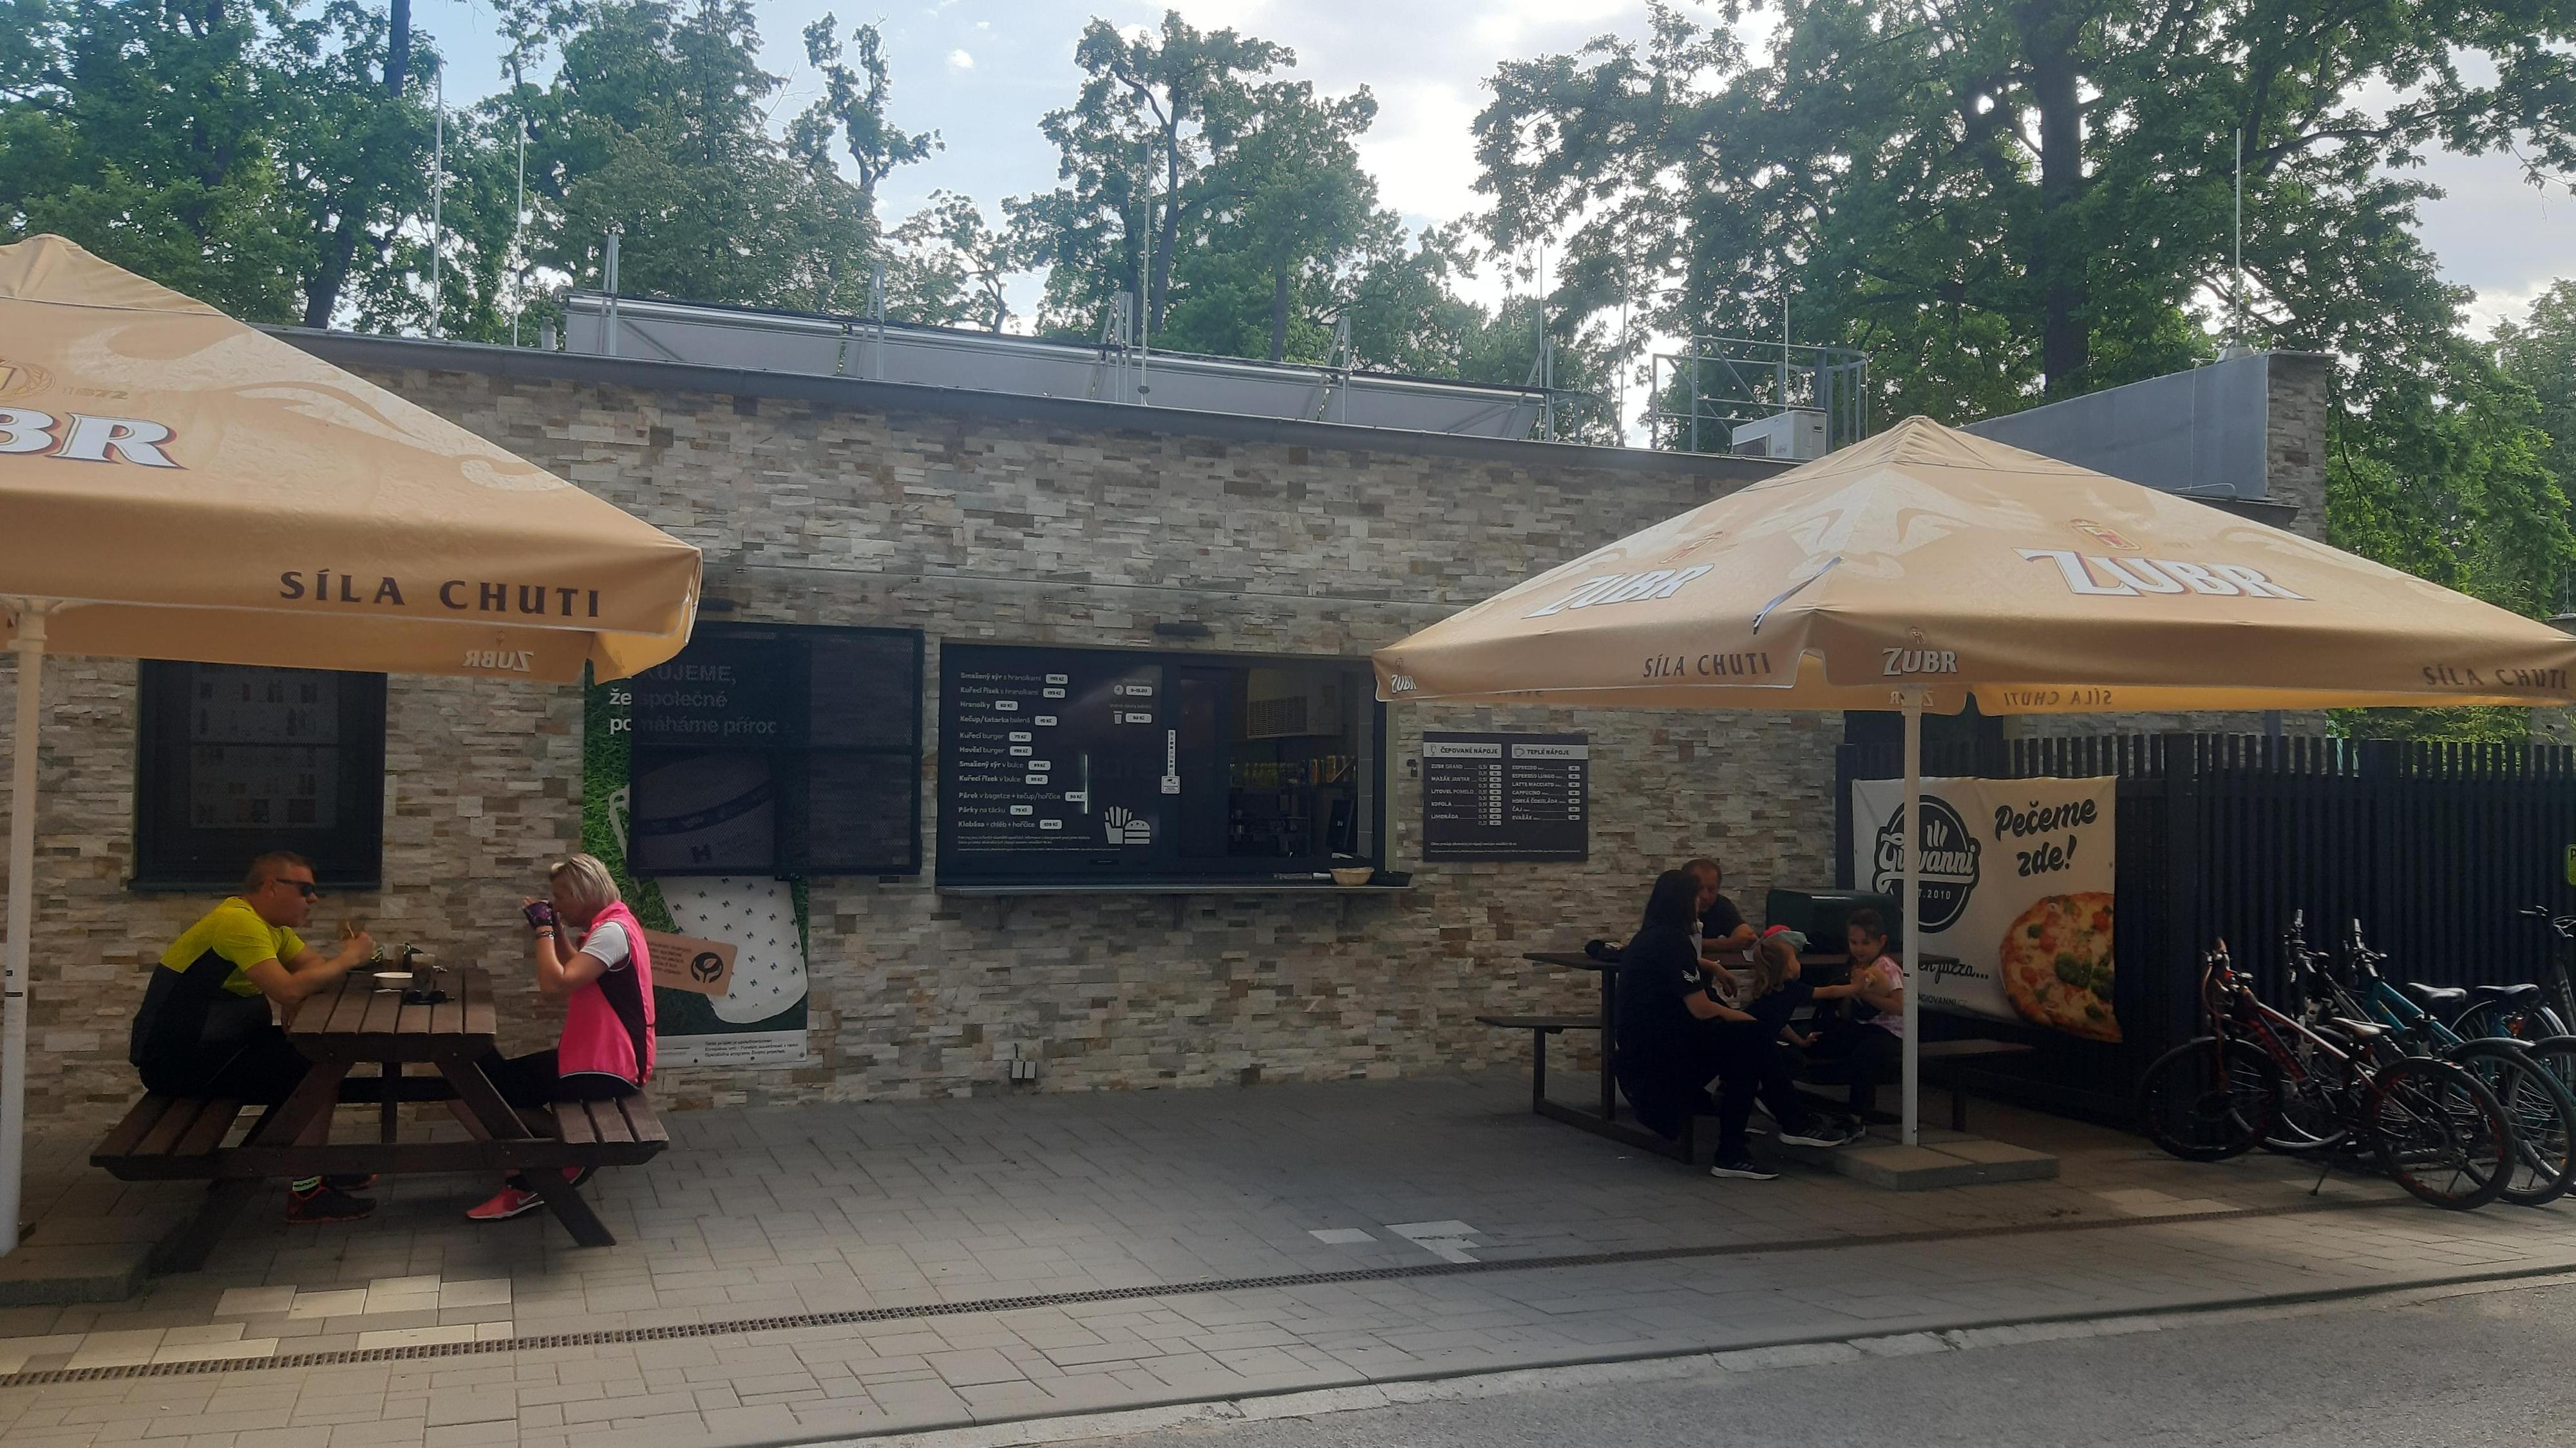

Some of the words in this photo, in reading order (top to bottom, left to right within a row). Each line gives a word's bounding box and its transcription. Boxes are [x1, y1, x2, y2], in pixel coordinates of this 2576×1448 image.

[0, 406, 191, 470] BR
[1521, 563, 1716, 619] ZUBR
[2011, 547, 2316, 602] ZUBR
[279, 569, 405, 606] SÍLA
[439, 579, 600, 618] CHUTI
[960, 672, 990, 681] Smažený
[1643, 653, 1686, 679] SÍLA
[1697, 652, 1772, 676] CHUTI
[1882, 646, 1958, 676] ZUBR
[2423, 664, 2486, 687] SÍLA
[2495, 669, 2568, 690] CHUTI
[609, 688, 632, 706] že
[1391, 674, 1417, 693] ZUBR
[959, 760, 989, 769] Smažený
[1995, 798, 2097, 842] Pečeme
[1876, 832, 1975, 891] Givanni
[2016, 834, 2077, 877] zde!
